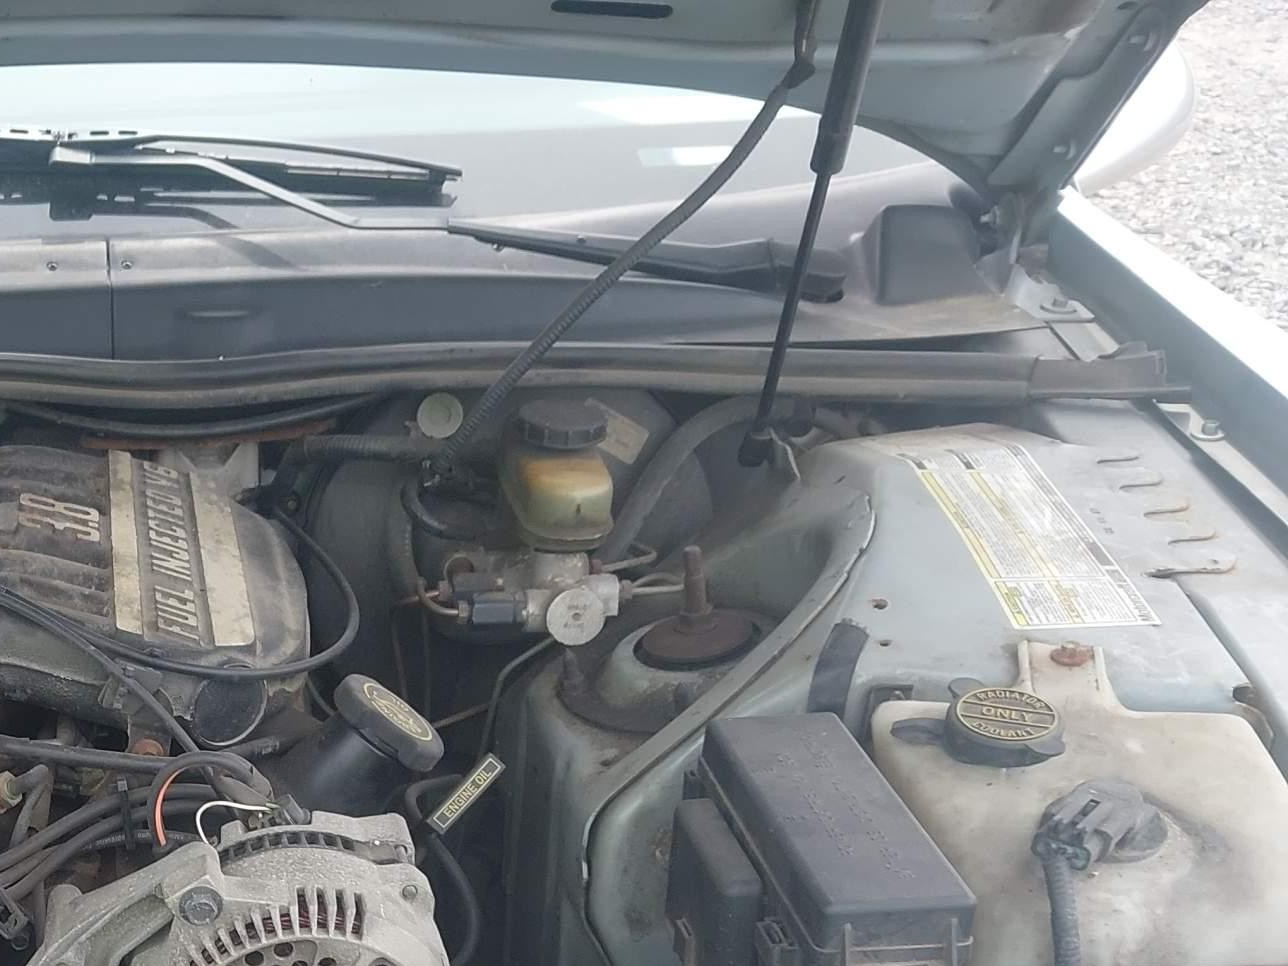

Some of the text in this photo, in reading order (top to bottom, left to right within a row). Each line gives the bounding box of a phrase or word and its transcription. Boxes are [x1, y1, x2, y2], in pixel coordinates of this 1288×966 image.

[18, 492, 101, 542] 3.8
[143, 460, 201, 640] FUEL INJECTED V6
[976, 690, 1045, 709] RADIATOR
[983, 706, 1033, 722] ONLY
[973, 721, 1035, 737] COOLANT
[443, 769, 492, 817] ENGINE OIL
